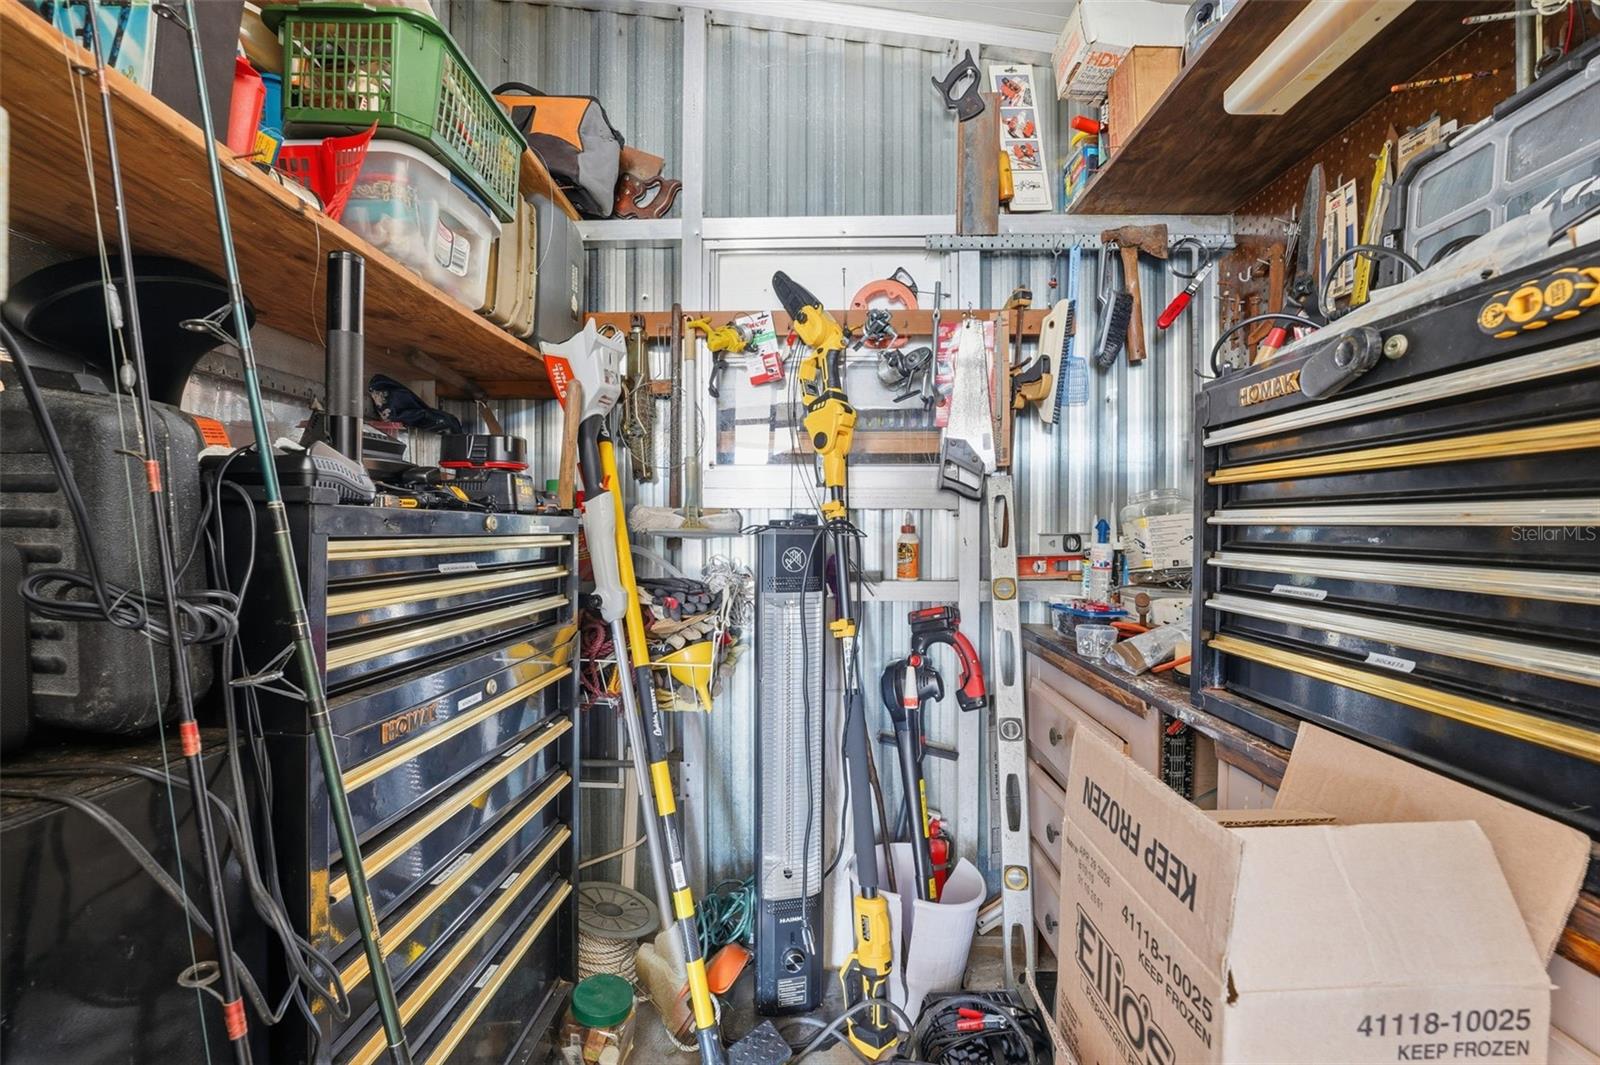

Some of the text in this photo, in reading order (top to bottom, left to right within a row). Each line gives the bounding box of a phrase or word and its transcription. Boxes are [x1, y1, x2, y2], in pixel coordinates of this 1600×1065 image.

[552, 363, 568, 398] STIHL
[1240, 369, 1301, 406] HOMAK
[1083, 776, 1141, 856] FROZEN
[1144, 838, 1197, 912] KEEP
[1121, 905, 1212, 1023] 41118-10025
[1138, 950, 1212, 1049] KEEP FROZEN
[1357, 1008, 1531, 1037] 41118-10025
[1397, 1040, 1530, 1060] KEEP FROZEN
